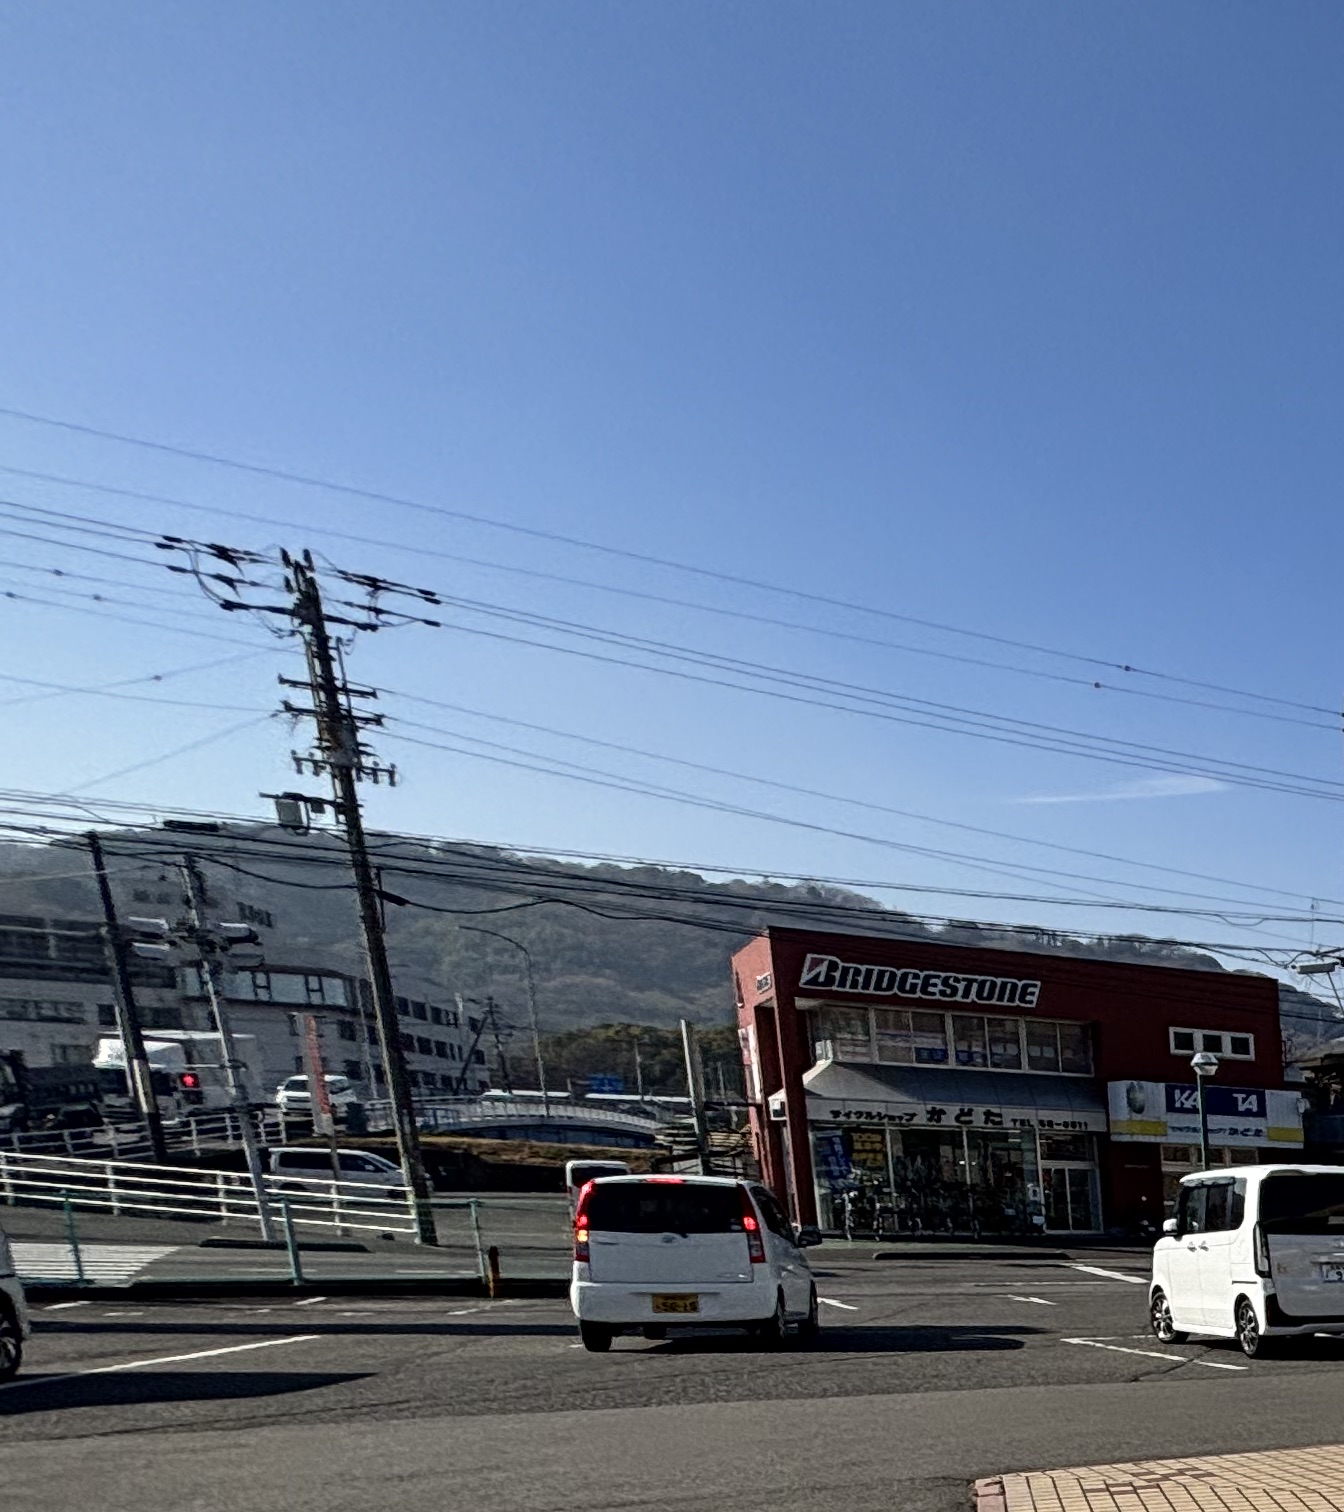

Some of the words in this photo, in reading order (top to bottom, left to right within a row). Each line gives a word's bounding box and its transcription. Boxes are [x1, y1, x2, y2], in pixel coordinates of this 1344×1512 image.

[799, 953, 1041, 1007] BRIDGESTONE
[926, 1106, 1003, 1126] かどた
[1011, 1118, 1033, 1129] TEL
